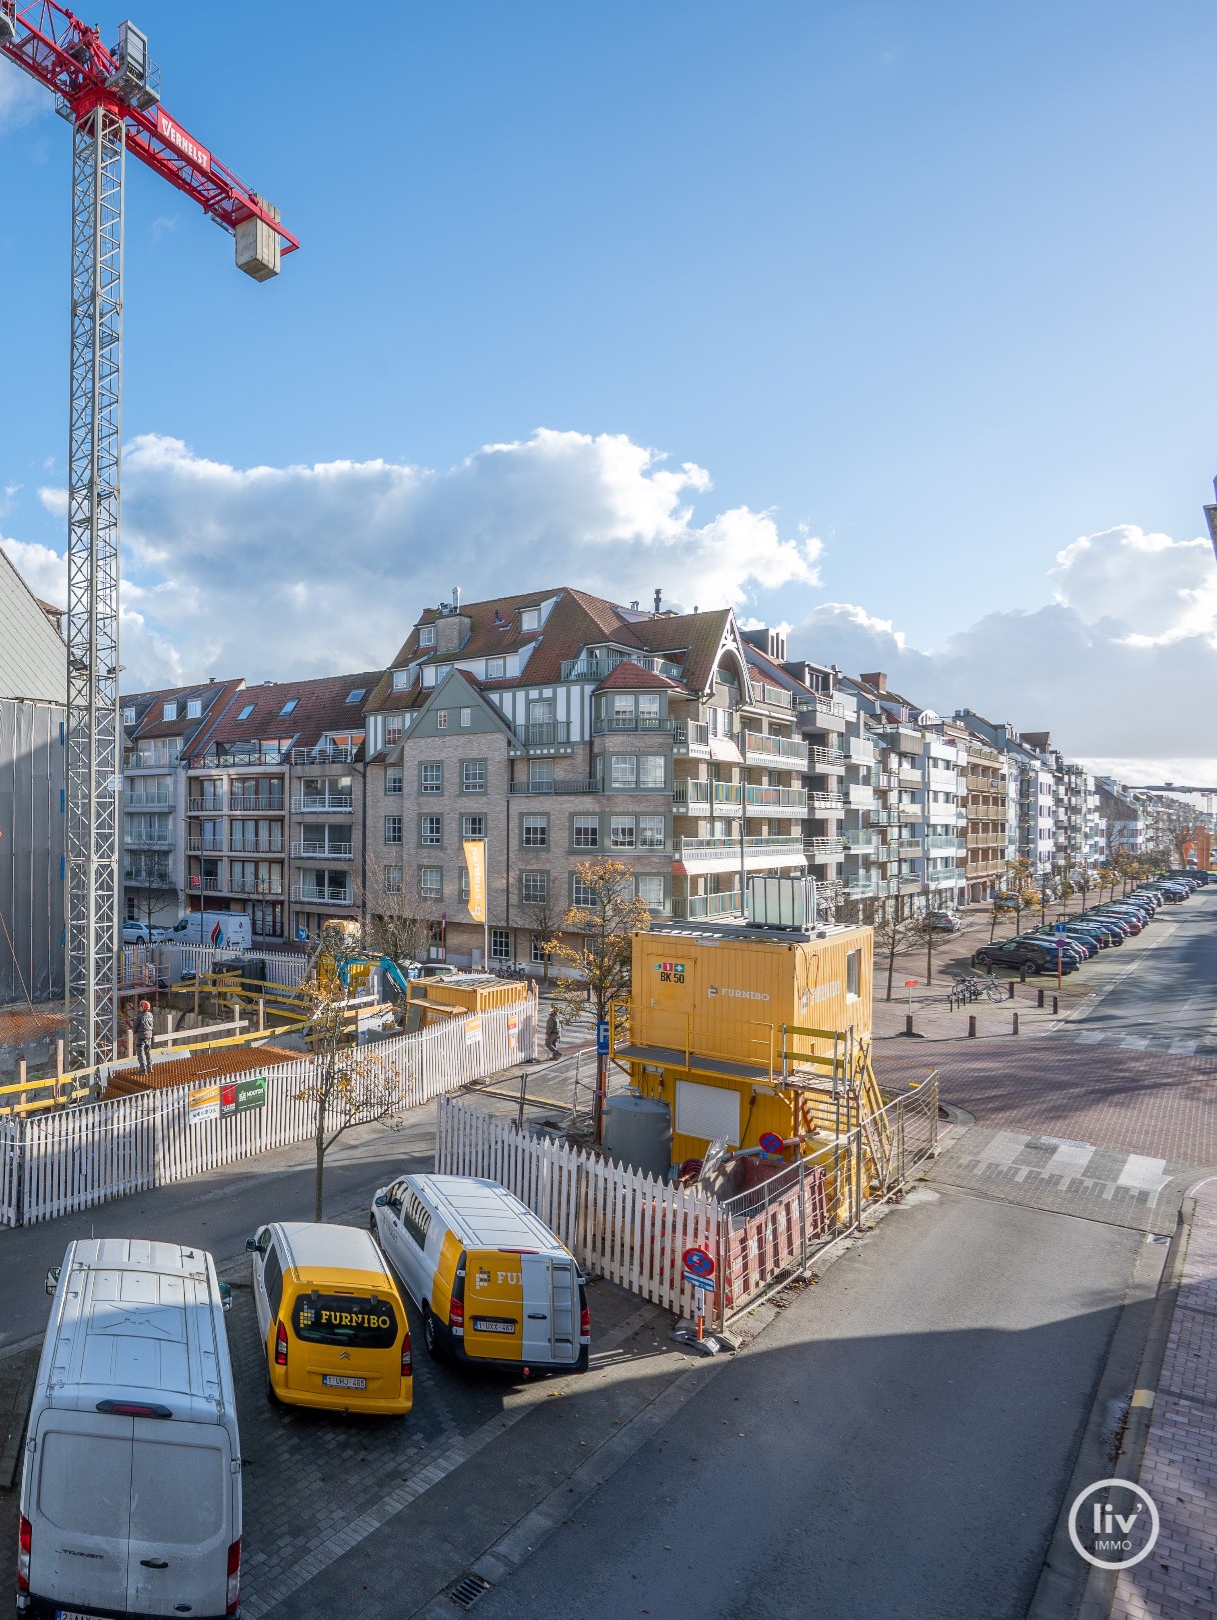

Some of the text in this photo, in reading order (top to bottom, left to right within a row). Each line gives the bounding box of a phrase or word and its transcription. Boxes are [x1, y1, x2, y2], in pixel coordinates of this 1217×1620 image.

[161, 117, 207, 168] VERHELST
[660, 971, 684, 983] BK 50
[721, 988, 770, 1001] FURNIBO
[321, 1310, 390, 1328] FURNIBO
[63, 1549, 104, 1559] TRANSIT
